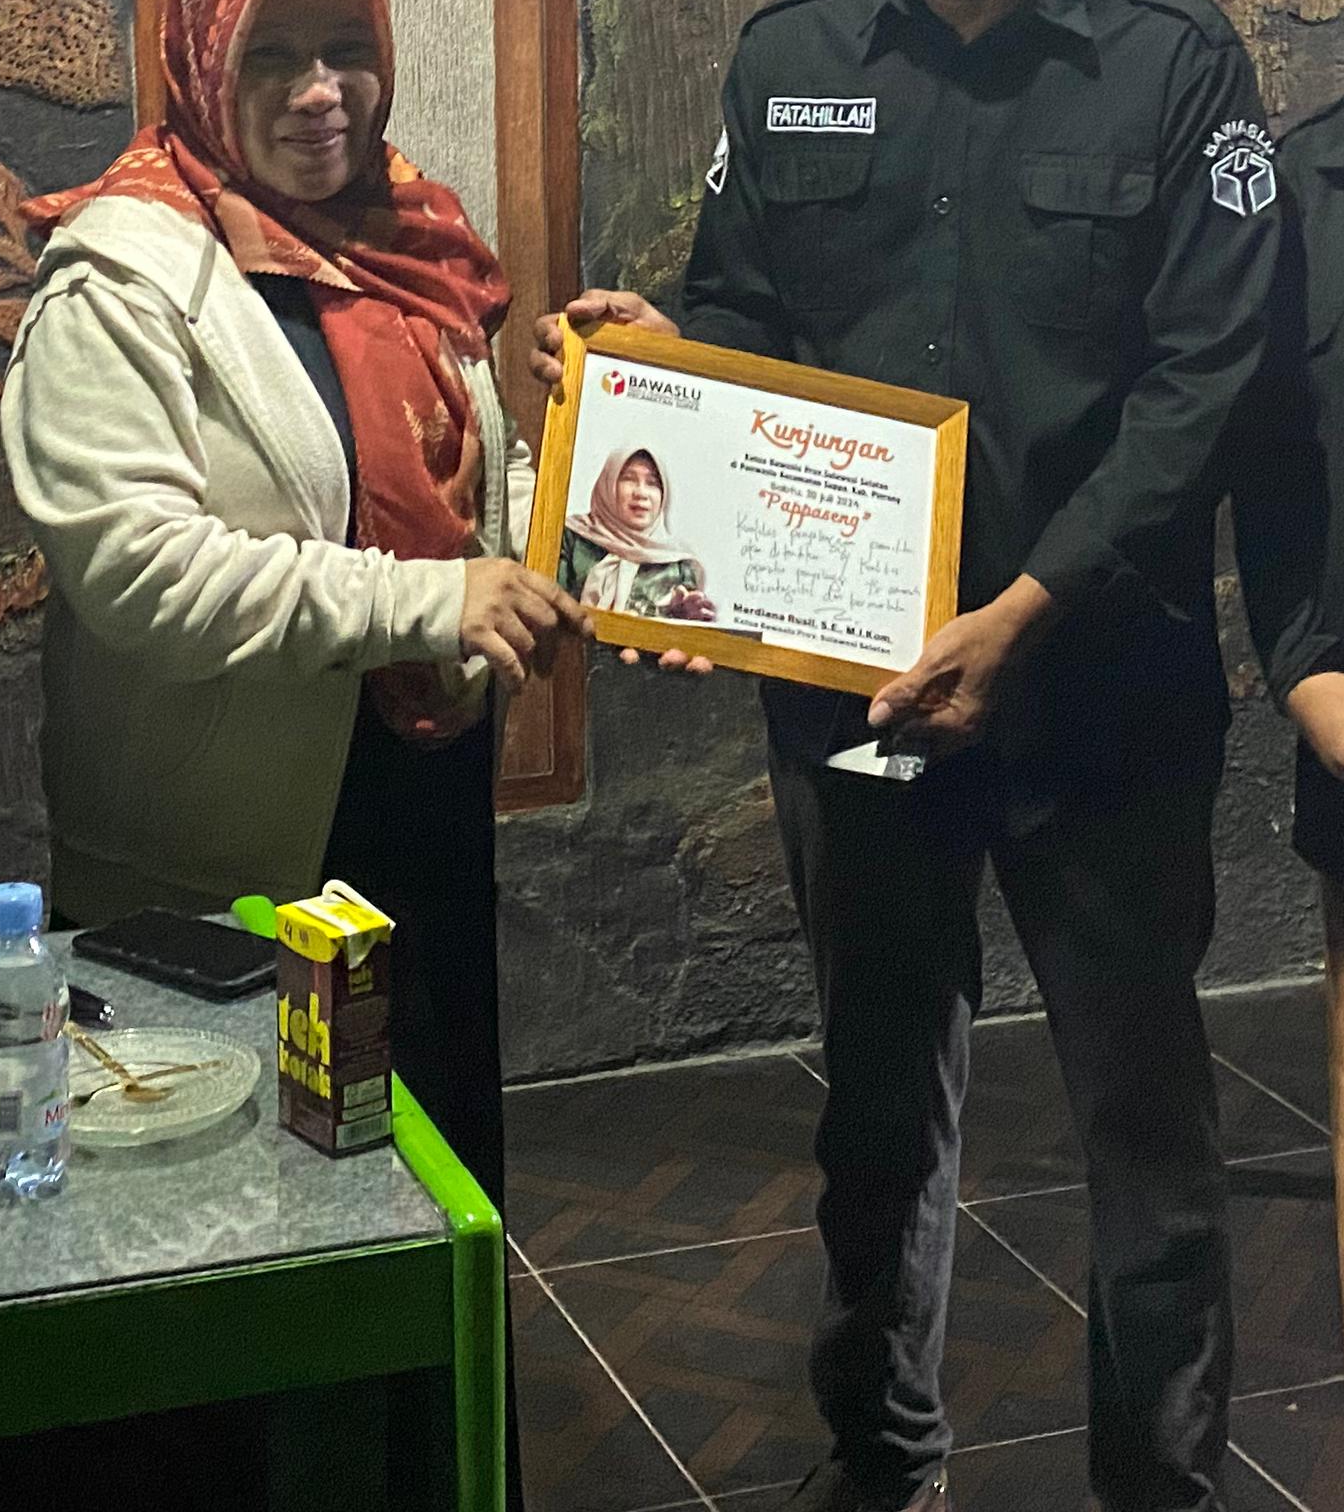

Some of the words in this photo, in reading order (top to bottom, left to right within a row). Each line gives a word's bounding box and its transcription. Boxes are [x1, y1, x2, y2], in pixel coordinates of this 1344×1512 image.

[772, 104, 871, 127] FATAHILLAH
[629, 375, 701, 401] BAWASLU
[751, 409, 894, 470] Kunjungan
[733, 602, 786, 622] Mardiana
